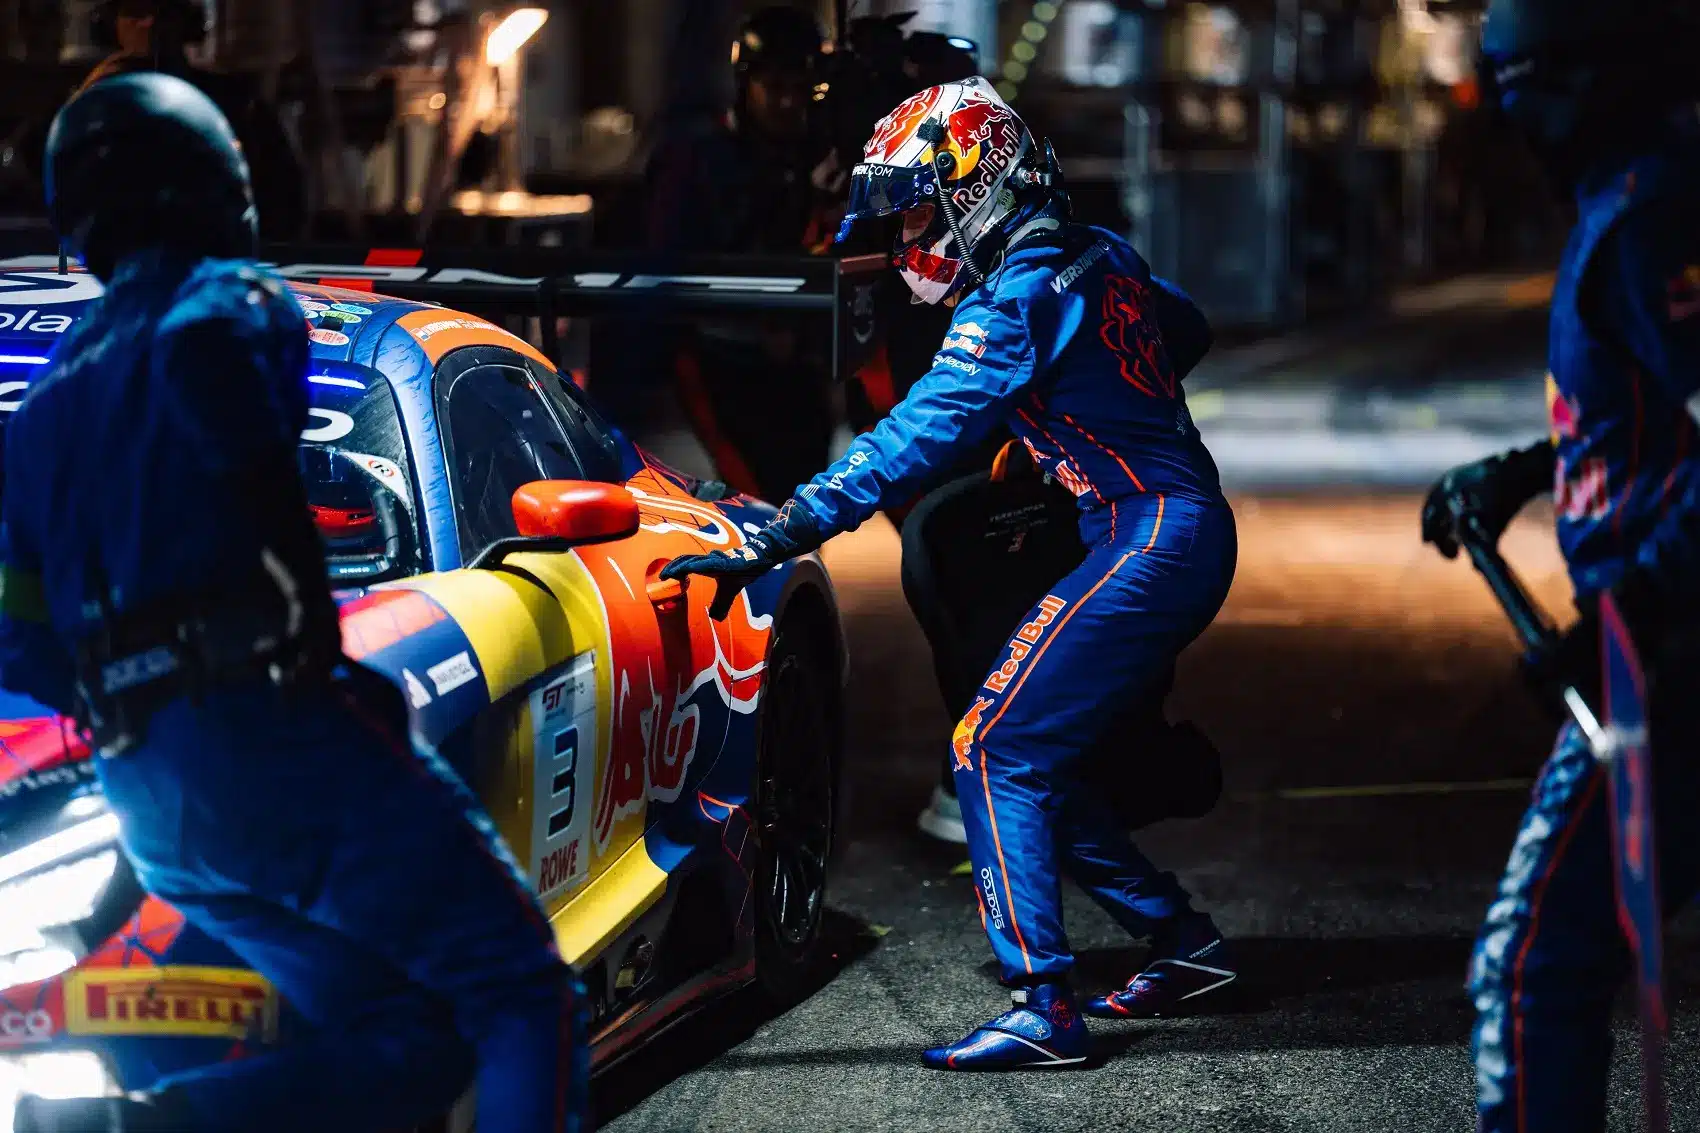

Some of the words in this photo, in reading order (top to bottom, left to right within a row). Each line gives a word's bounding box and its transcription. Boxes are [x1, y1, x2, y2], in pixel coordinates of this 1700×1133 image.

[952, 159, 1000, 214] Red
[985, 124, 1021, 172] Bull
[983, 638, 1032, 694] Red
[1016, 594, 1067, 644] Bull
[546, 723, 580, 841] 3
[539, 839, 579, 893] ROWE
